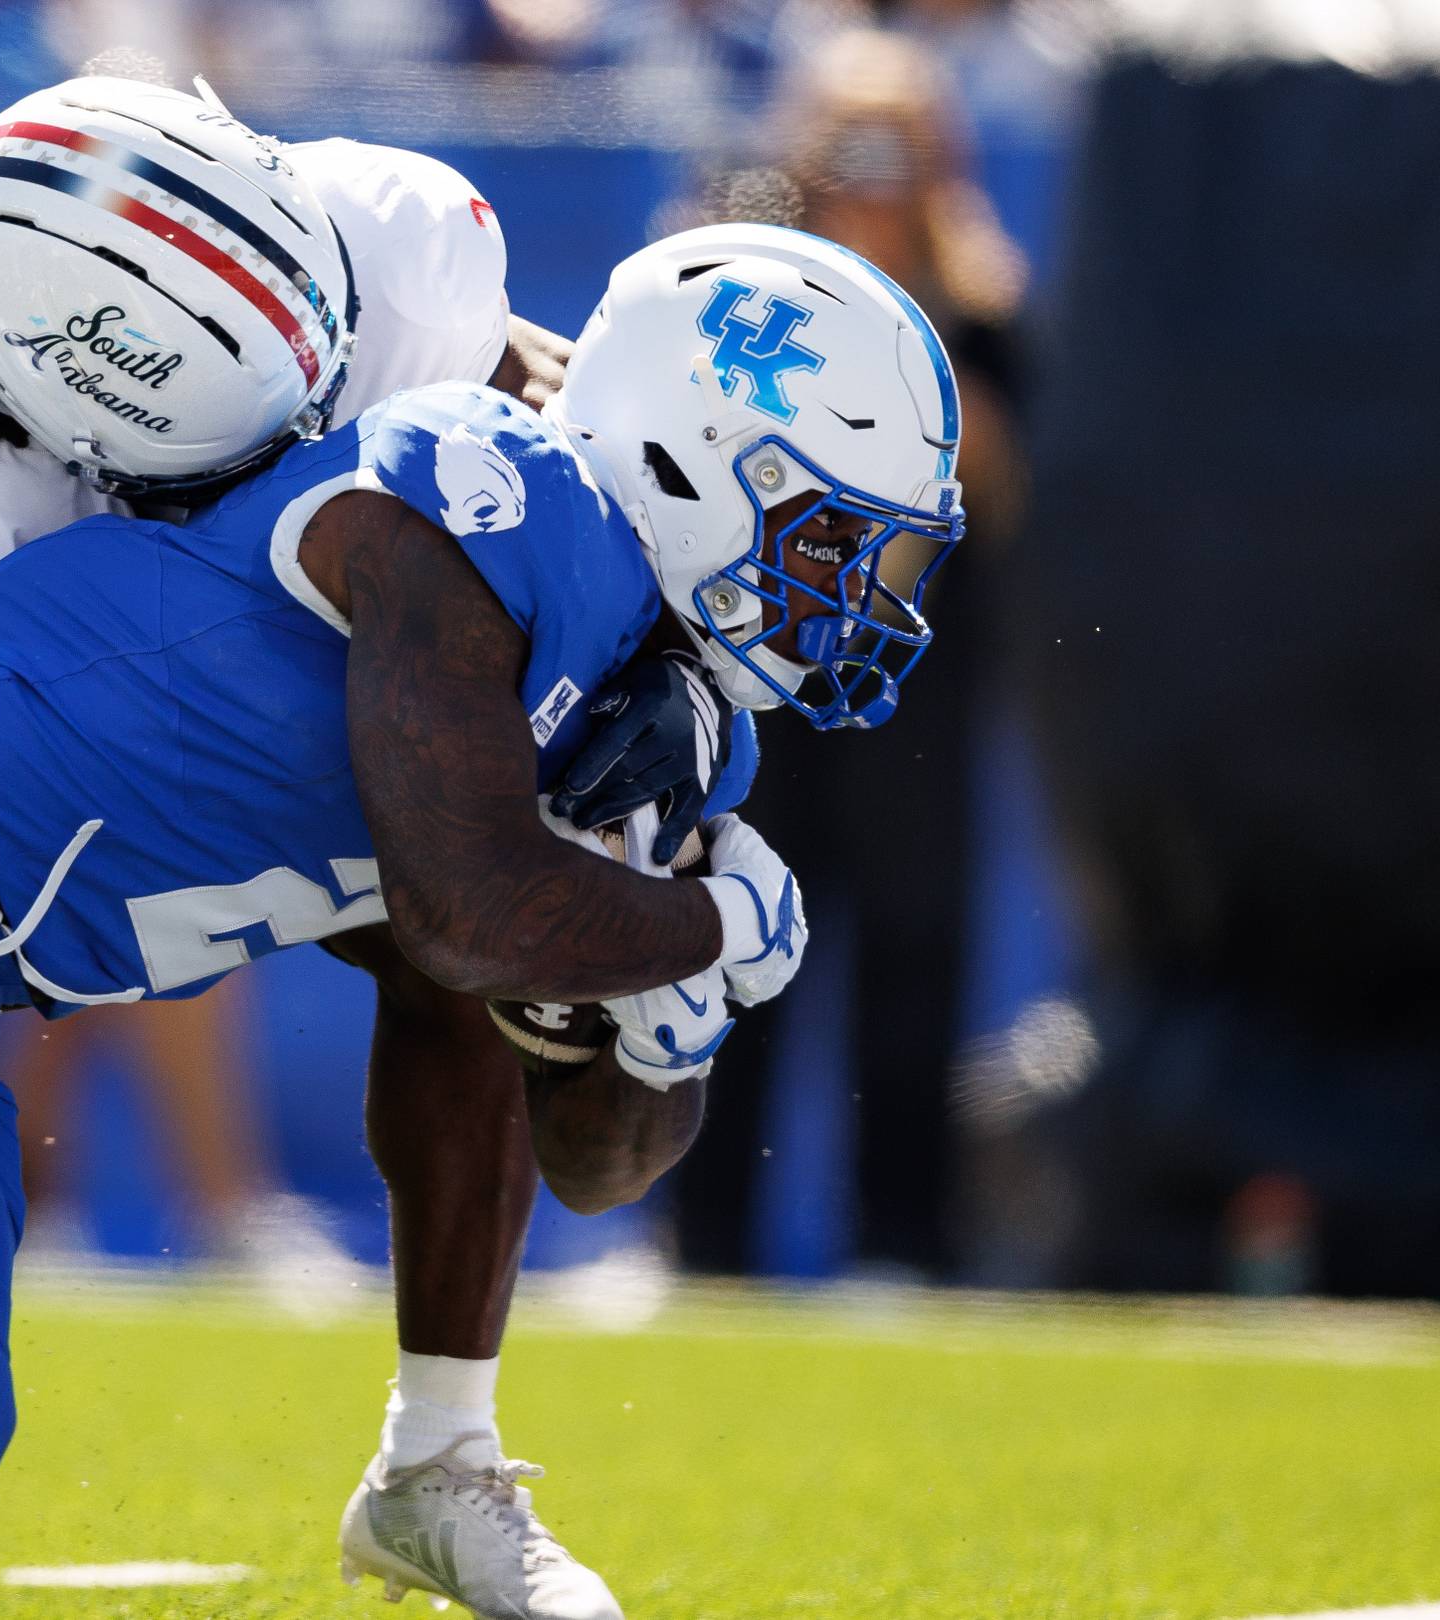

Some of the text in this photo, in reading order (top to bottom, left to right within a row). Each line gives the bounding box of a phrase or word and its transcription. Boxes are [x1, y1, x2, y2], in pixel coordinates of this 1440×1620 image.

[3, 331, 173, 434] Alabama
[66, 305, 183, 390] South
[690, 275, 826, 427] UK
[125, 857, 389, 993] 2
